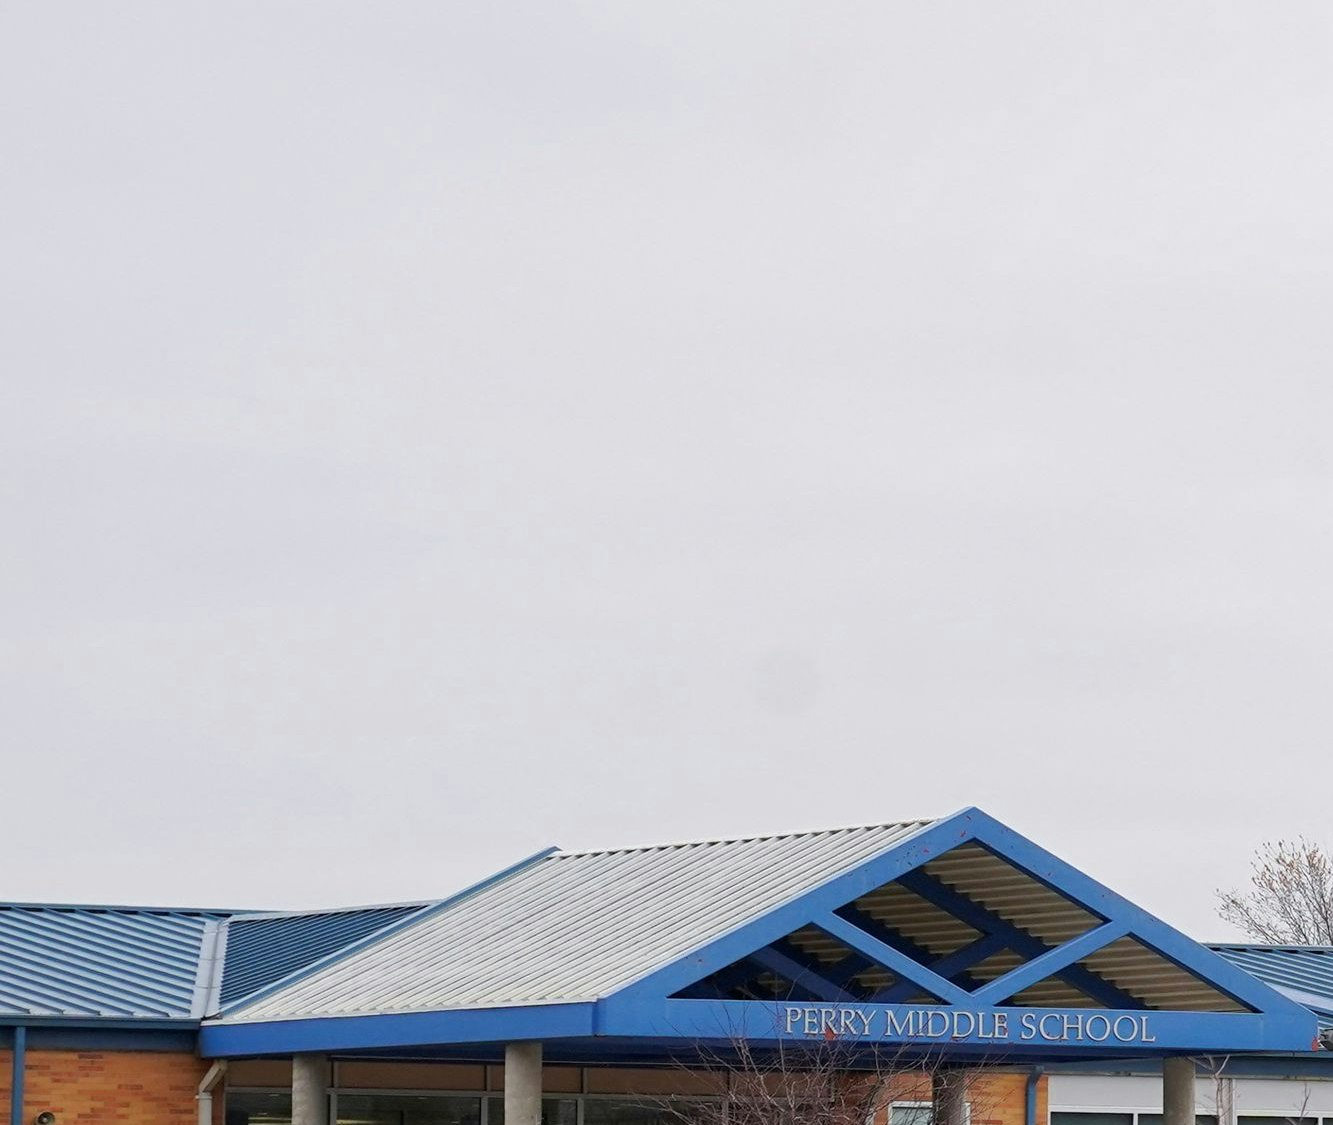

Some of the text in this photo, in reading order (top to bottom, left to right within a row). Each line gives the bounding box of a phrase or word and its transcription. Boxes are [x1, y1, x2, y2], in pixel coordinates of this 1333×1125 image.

[785, 1007, 1155, 1043] PERRY MIDDLE SCHOOL
